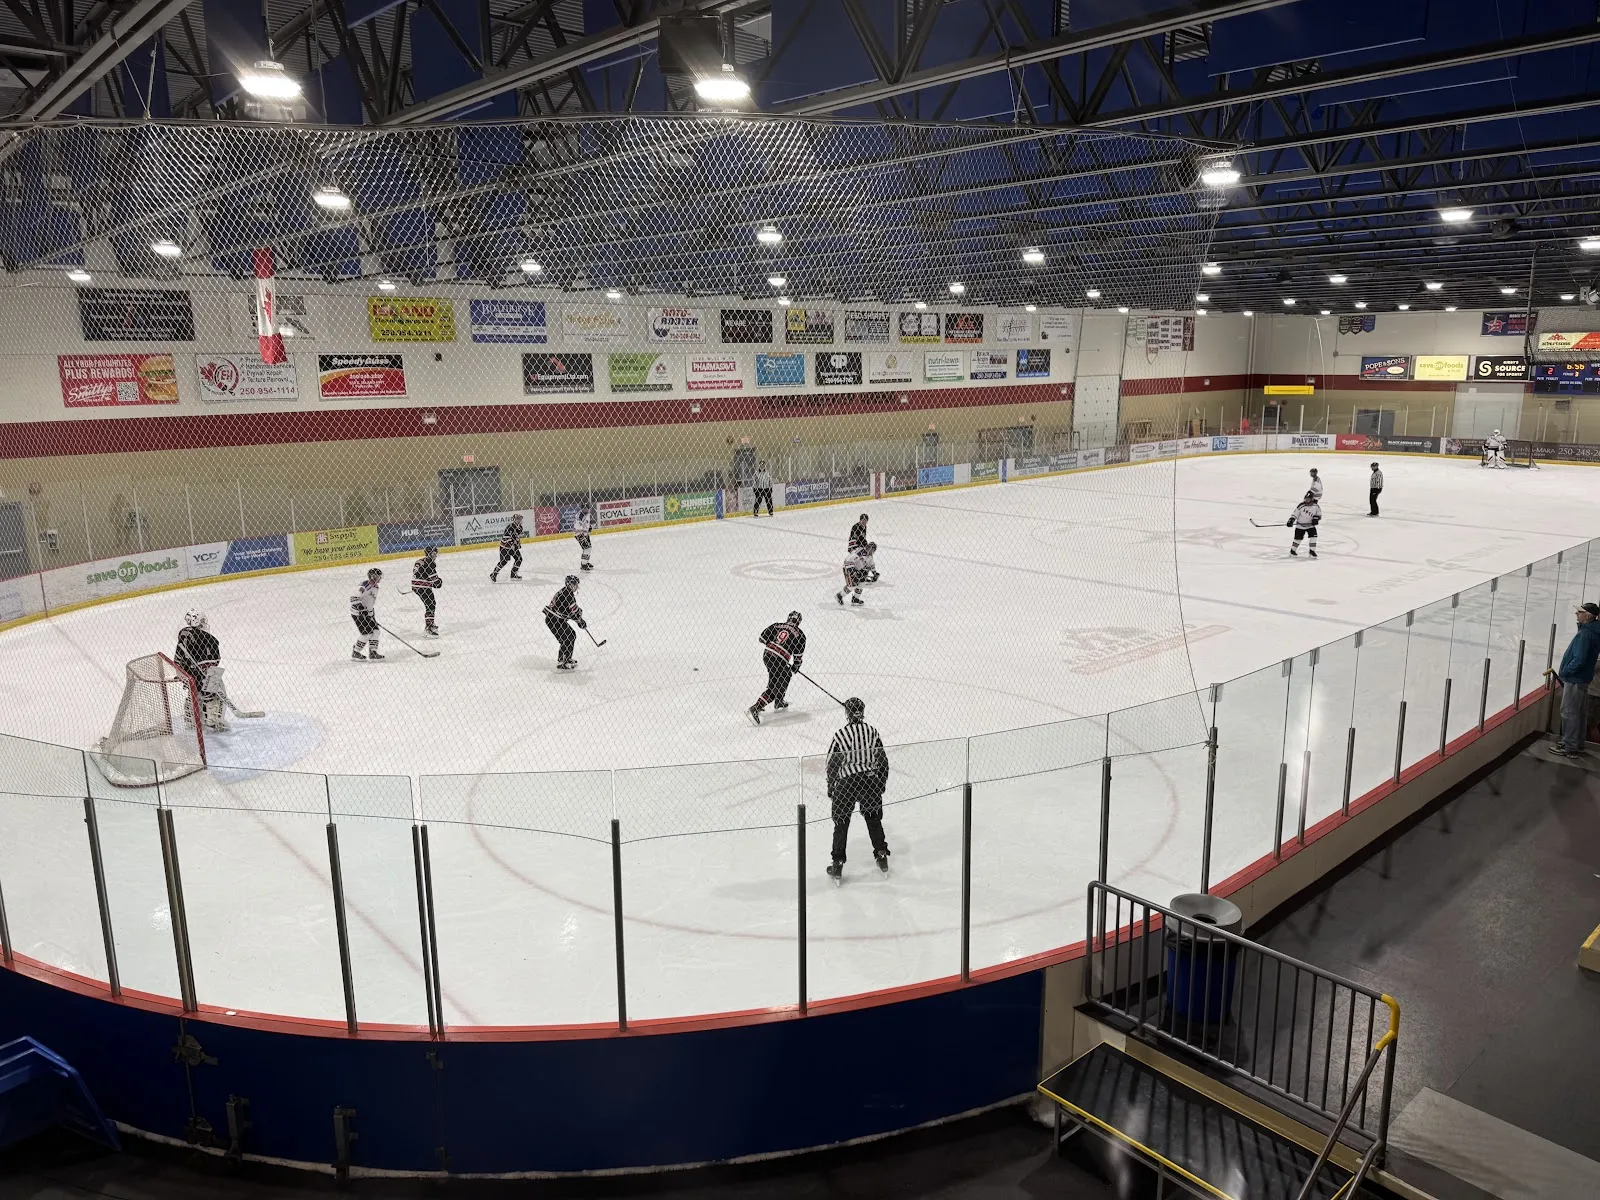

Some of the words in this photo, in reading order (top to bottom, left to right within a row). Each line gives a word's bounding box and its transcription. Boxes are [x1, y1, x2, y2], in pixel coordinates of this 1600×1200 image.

[332, 357, 365, 366] Speedy
[693, 361, 736, 371] PHARMASAVE
[1364, 362, 1383, 370] POPE
[1386, 357, 1406, 366] SONS
[65, 368, 88, 379] PLUS
[90, 367, 136, 379] REWARDS!
[1547, 367, 1554, 375] 2
[1291, 437, 1329, 446] BOATHOUSE
[600, 509, 628, 520] ROYAL
[329, 531, 357, 542] Supply
[401, 527, 420, 537] HUB
[86, 570, 118, 585] save
[137, 556, 179, 574] foods
[777, 630, 790, 644] 9
